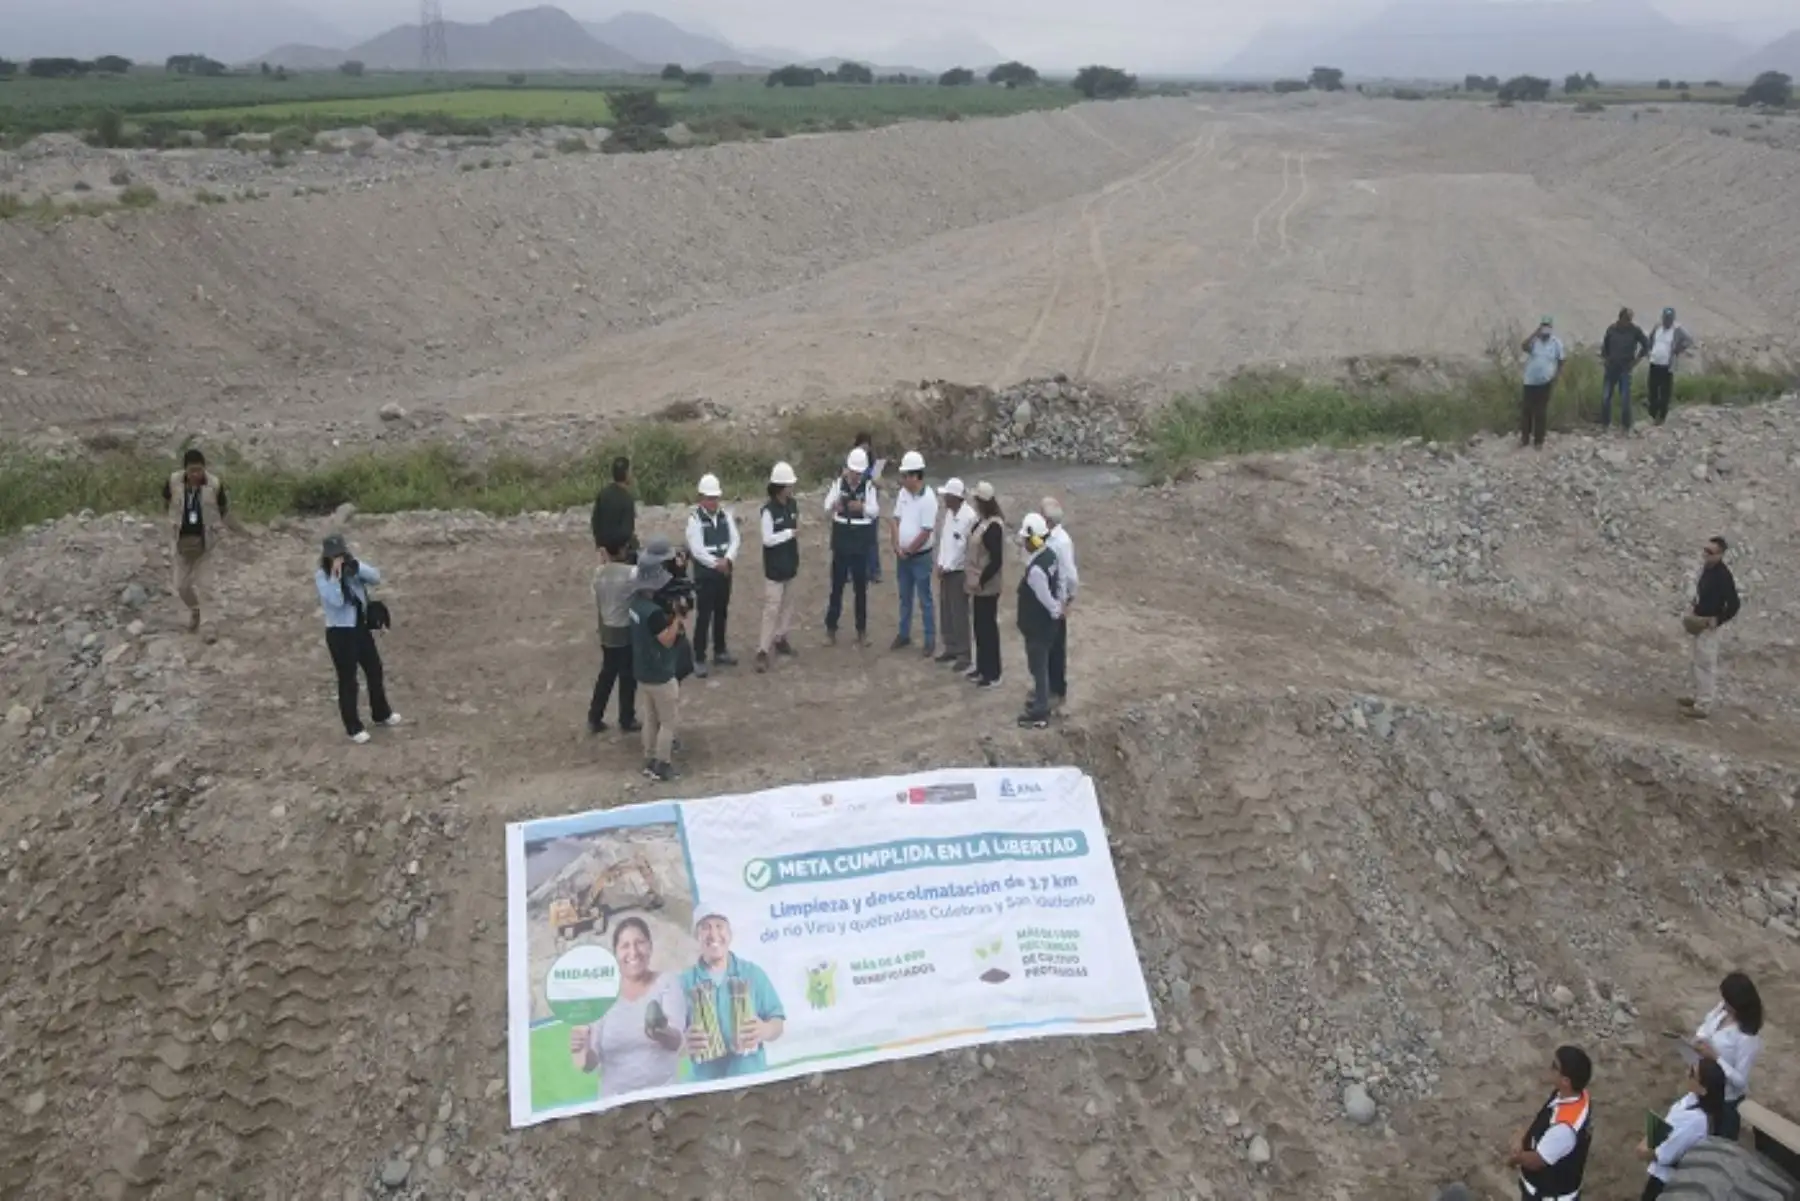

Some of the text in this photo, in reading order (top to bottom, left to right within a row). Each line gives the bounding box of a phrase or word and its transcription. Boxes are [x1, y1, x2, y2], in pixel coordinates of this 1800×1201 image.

[777, 837, 1078, 878] META CUMPLIDA EN LA LIBERTAD
[770, 894, 849, 919] Limpieza
[852, 897, 862, 914] y
[865, 877, 1002, 907] descolmatación
[1004, 874, 1025, 890] de
[1051, 874, 1078, 888] km
[760, 927, 779, 944] de
[838, 921, 846, 936] y
[850, 907, 928, 933] quebradas
[554, 965, 615, 979] MIDAGRI
